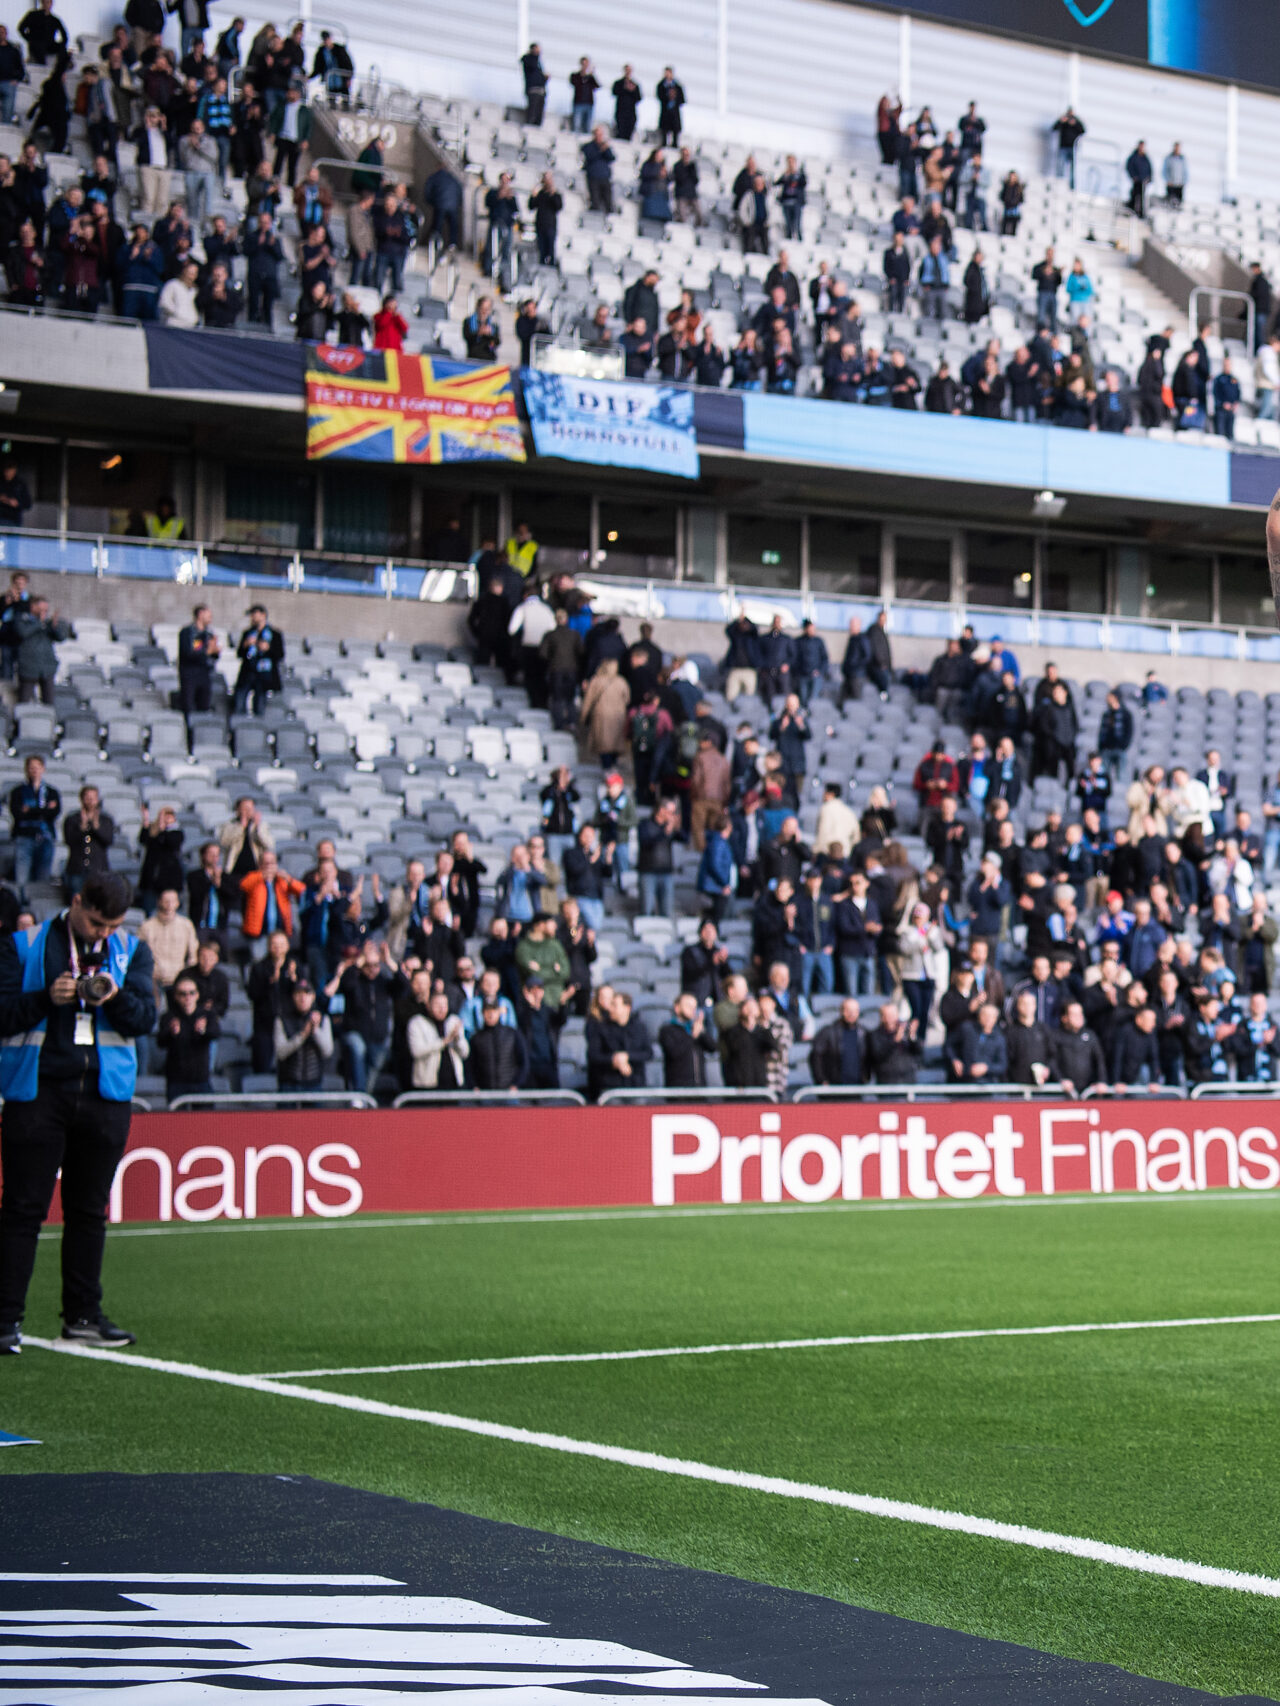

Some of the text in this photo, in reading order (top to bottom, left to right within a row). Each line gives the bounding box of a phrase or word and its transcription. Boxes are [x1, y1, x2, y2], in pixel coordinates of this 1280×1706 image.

[578, 392, 640, 415] DIF
[110, 1143, 363, 1223] nans
[652, 1109, 1280, 1205] Prioritet Finans
